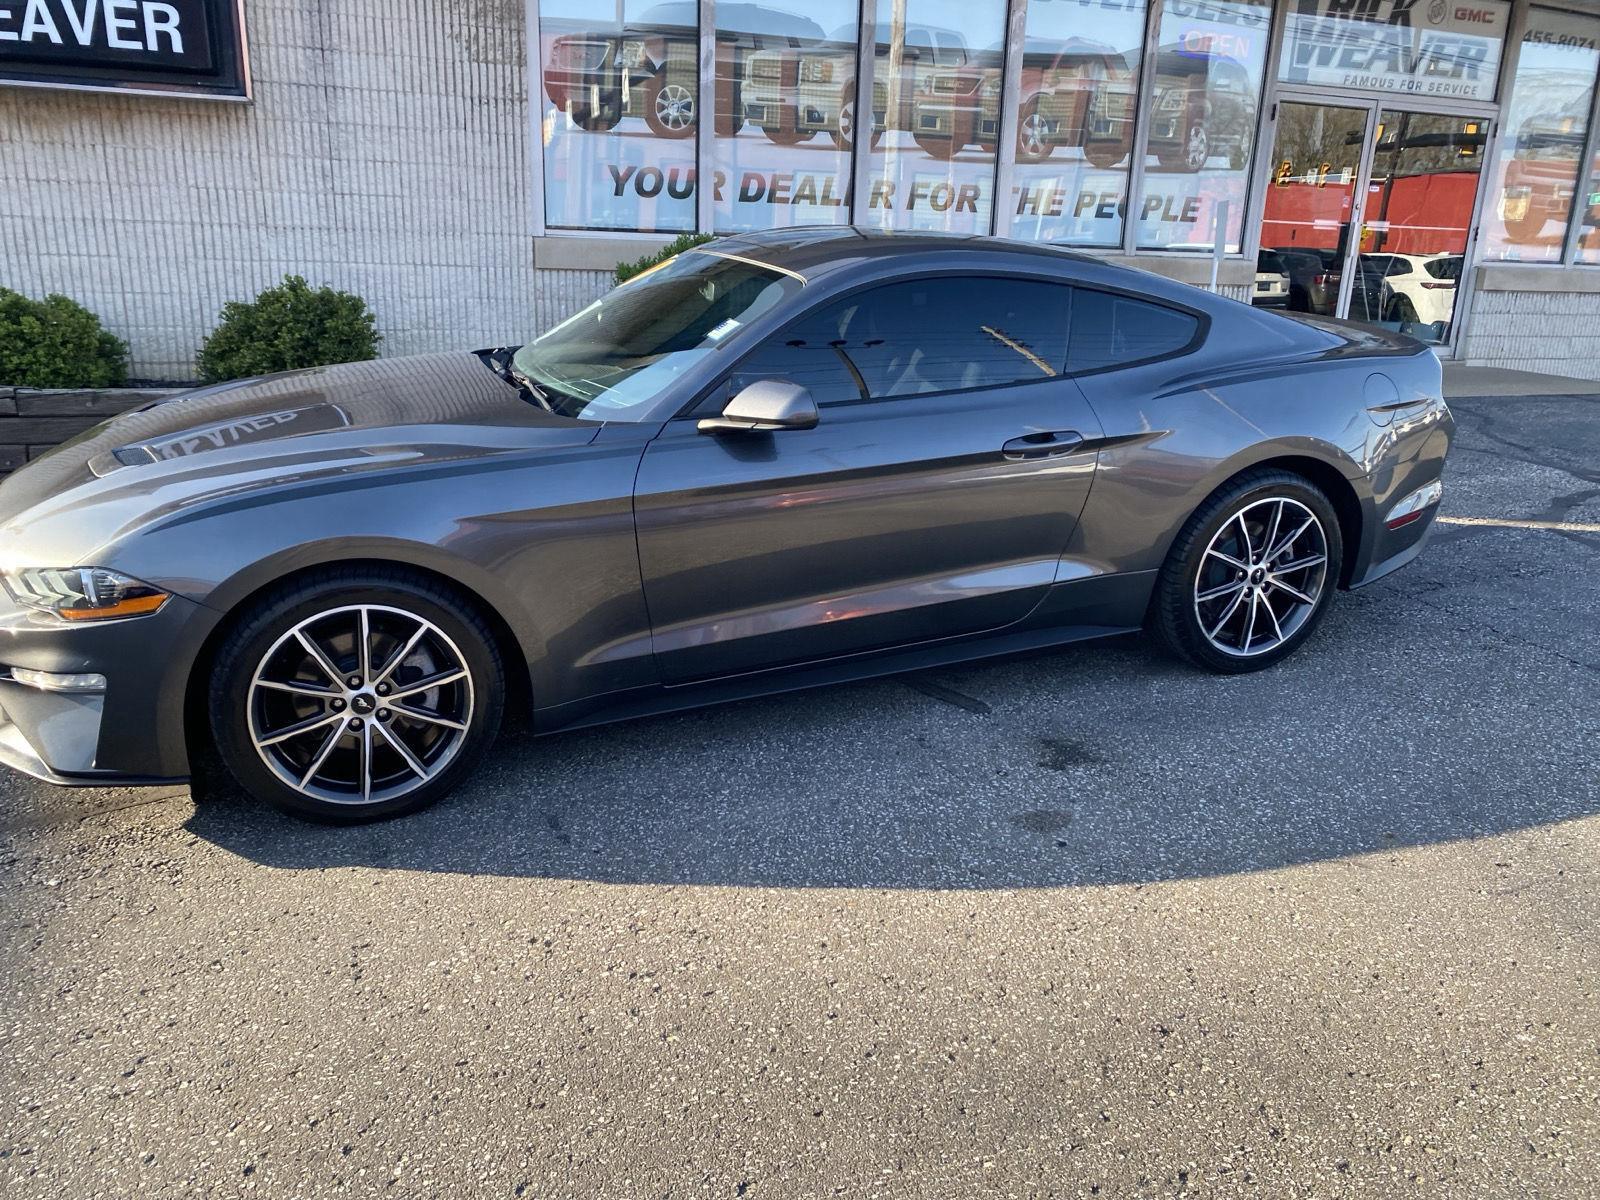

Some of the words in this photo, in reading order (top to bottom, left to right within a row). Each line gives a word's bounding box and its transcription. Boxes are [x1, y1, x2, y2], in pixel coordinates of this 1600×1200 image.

[1454, 7, 1495, 24] GMC
[1183, 30, 1250, 58] OPEN
[1296, 17, 1490, 82] WEAVER
[1343, 74, 1395, 89] FAMOUS
[1400, 79, 1423, 91] FOR
[1428, 82, 1479, 96] SERVICE
[738, 172, 896, 209] DEALR
[906, 181, 982, 213] FOR
